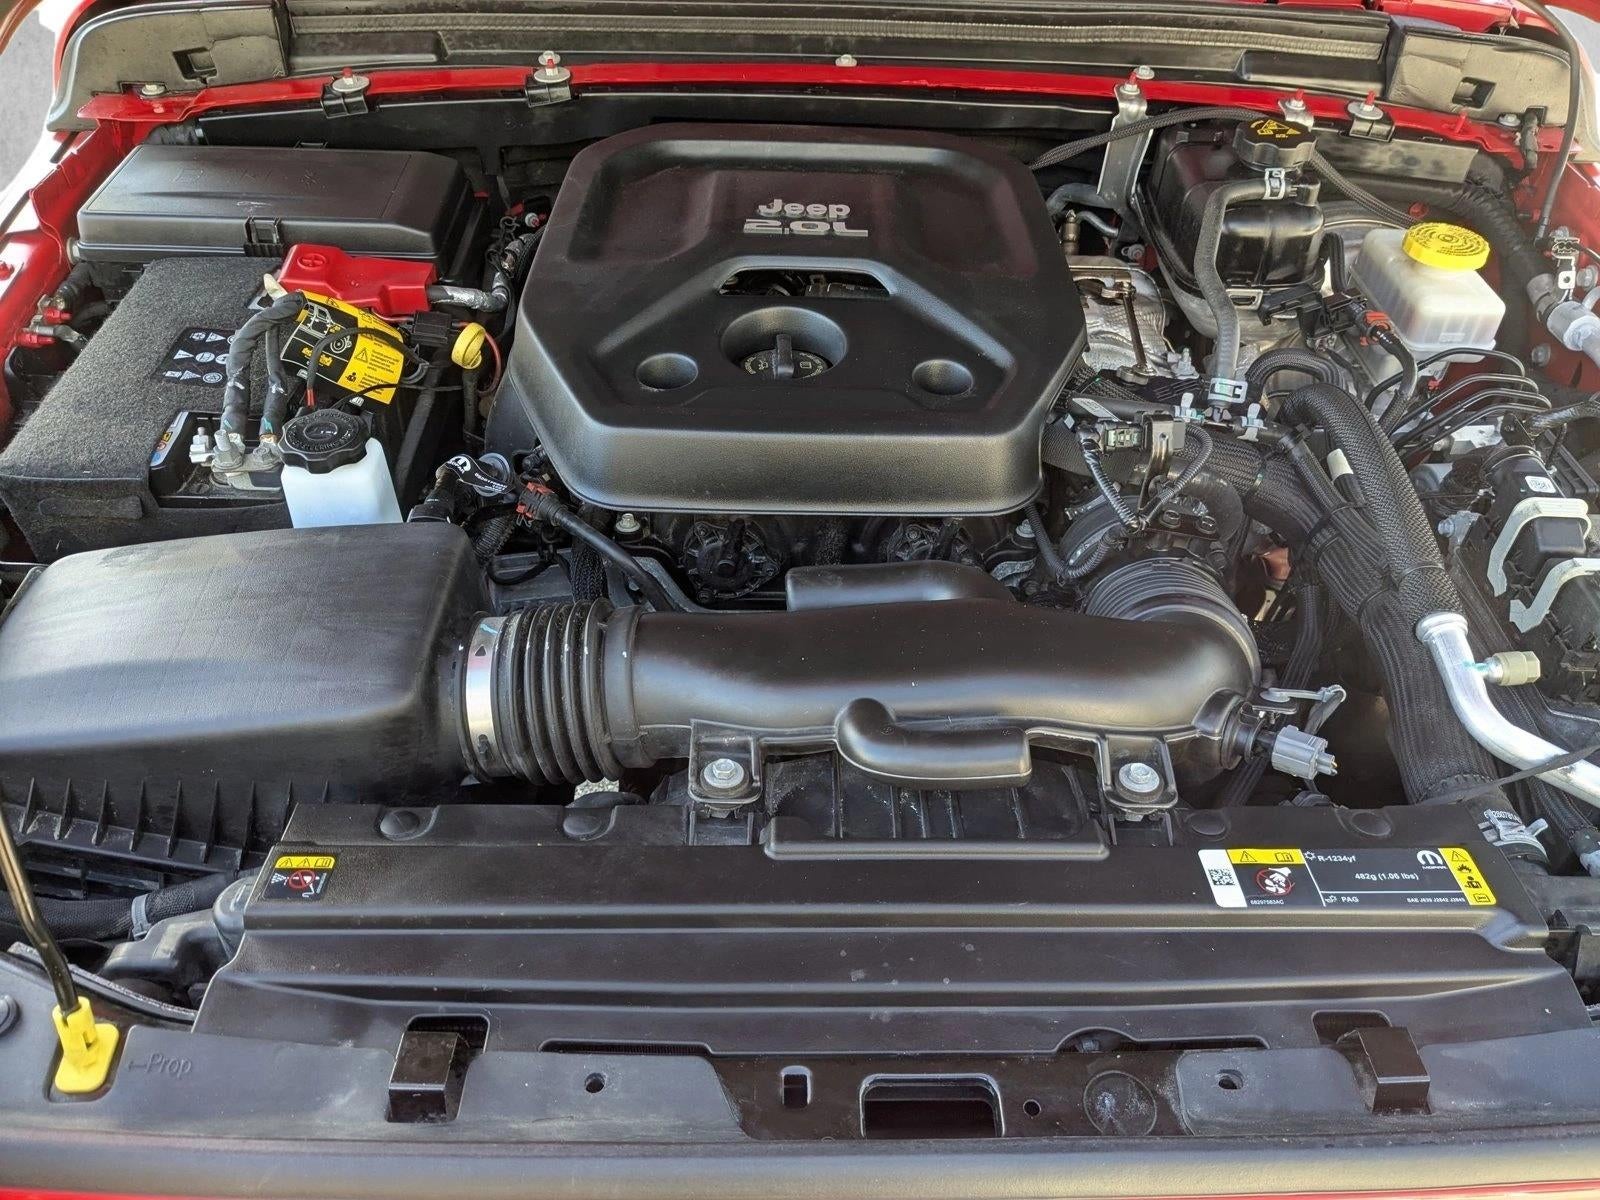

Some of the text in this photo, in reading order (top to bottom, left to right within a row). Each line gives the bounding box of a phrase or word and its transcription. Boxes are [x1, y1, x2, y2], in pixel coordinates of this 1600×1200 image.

[757, 199, 851, 220] Jeep
[743, 218, 869, 237] 2.0L
[1318, 855, 1357, 863] R-1234yf
[1354, 872, 1377, 881] 482g
[1401, 872, 1419, 881] lbs)
[146, 1052, 192, 1079] Prop
